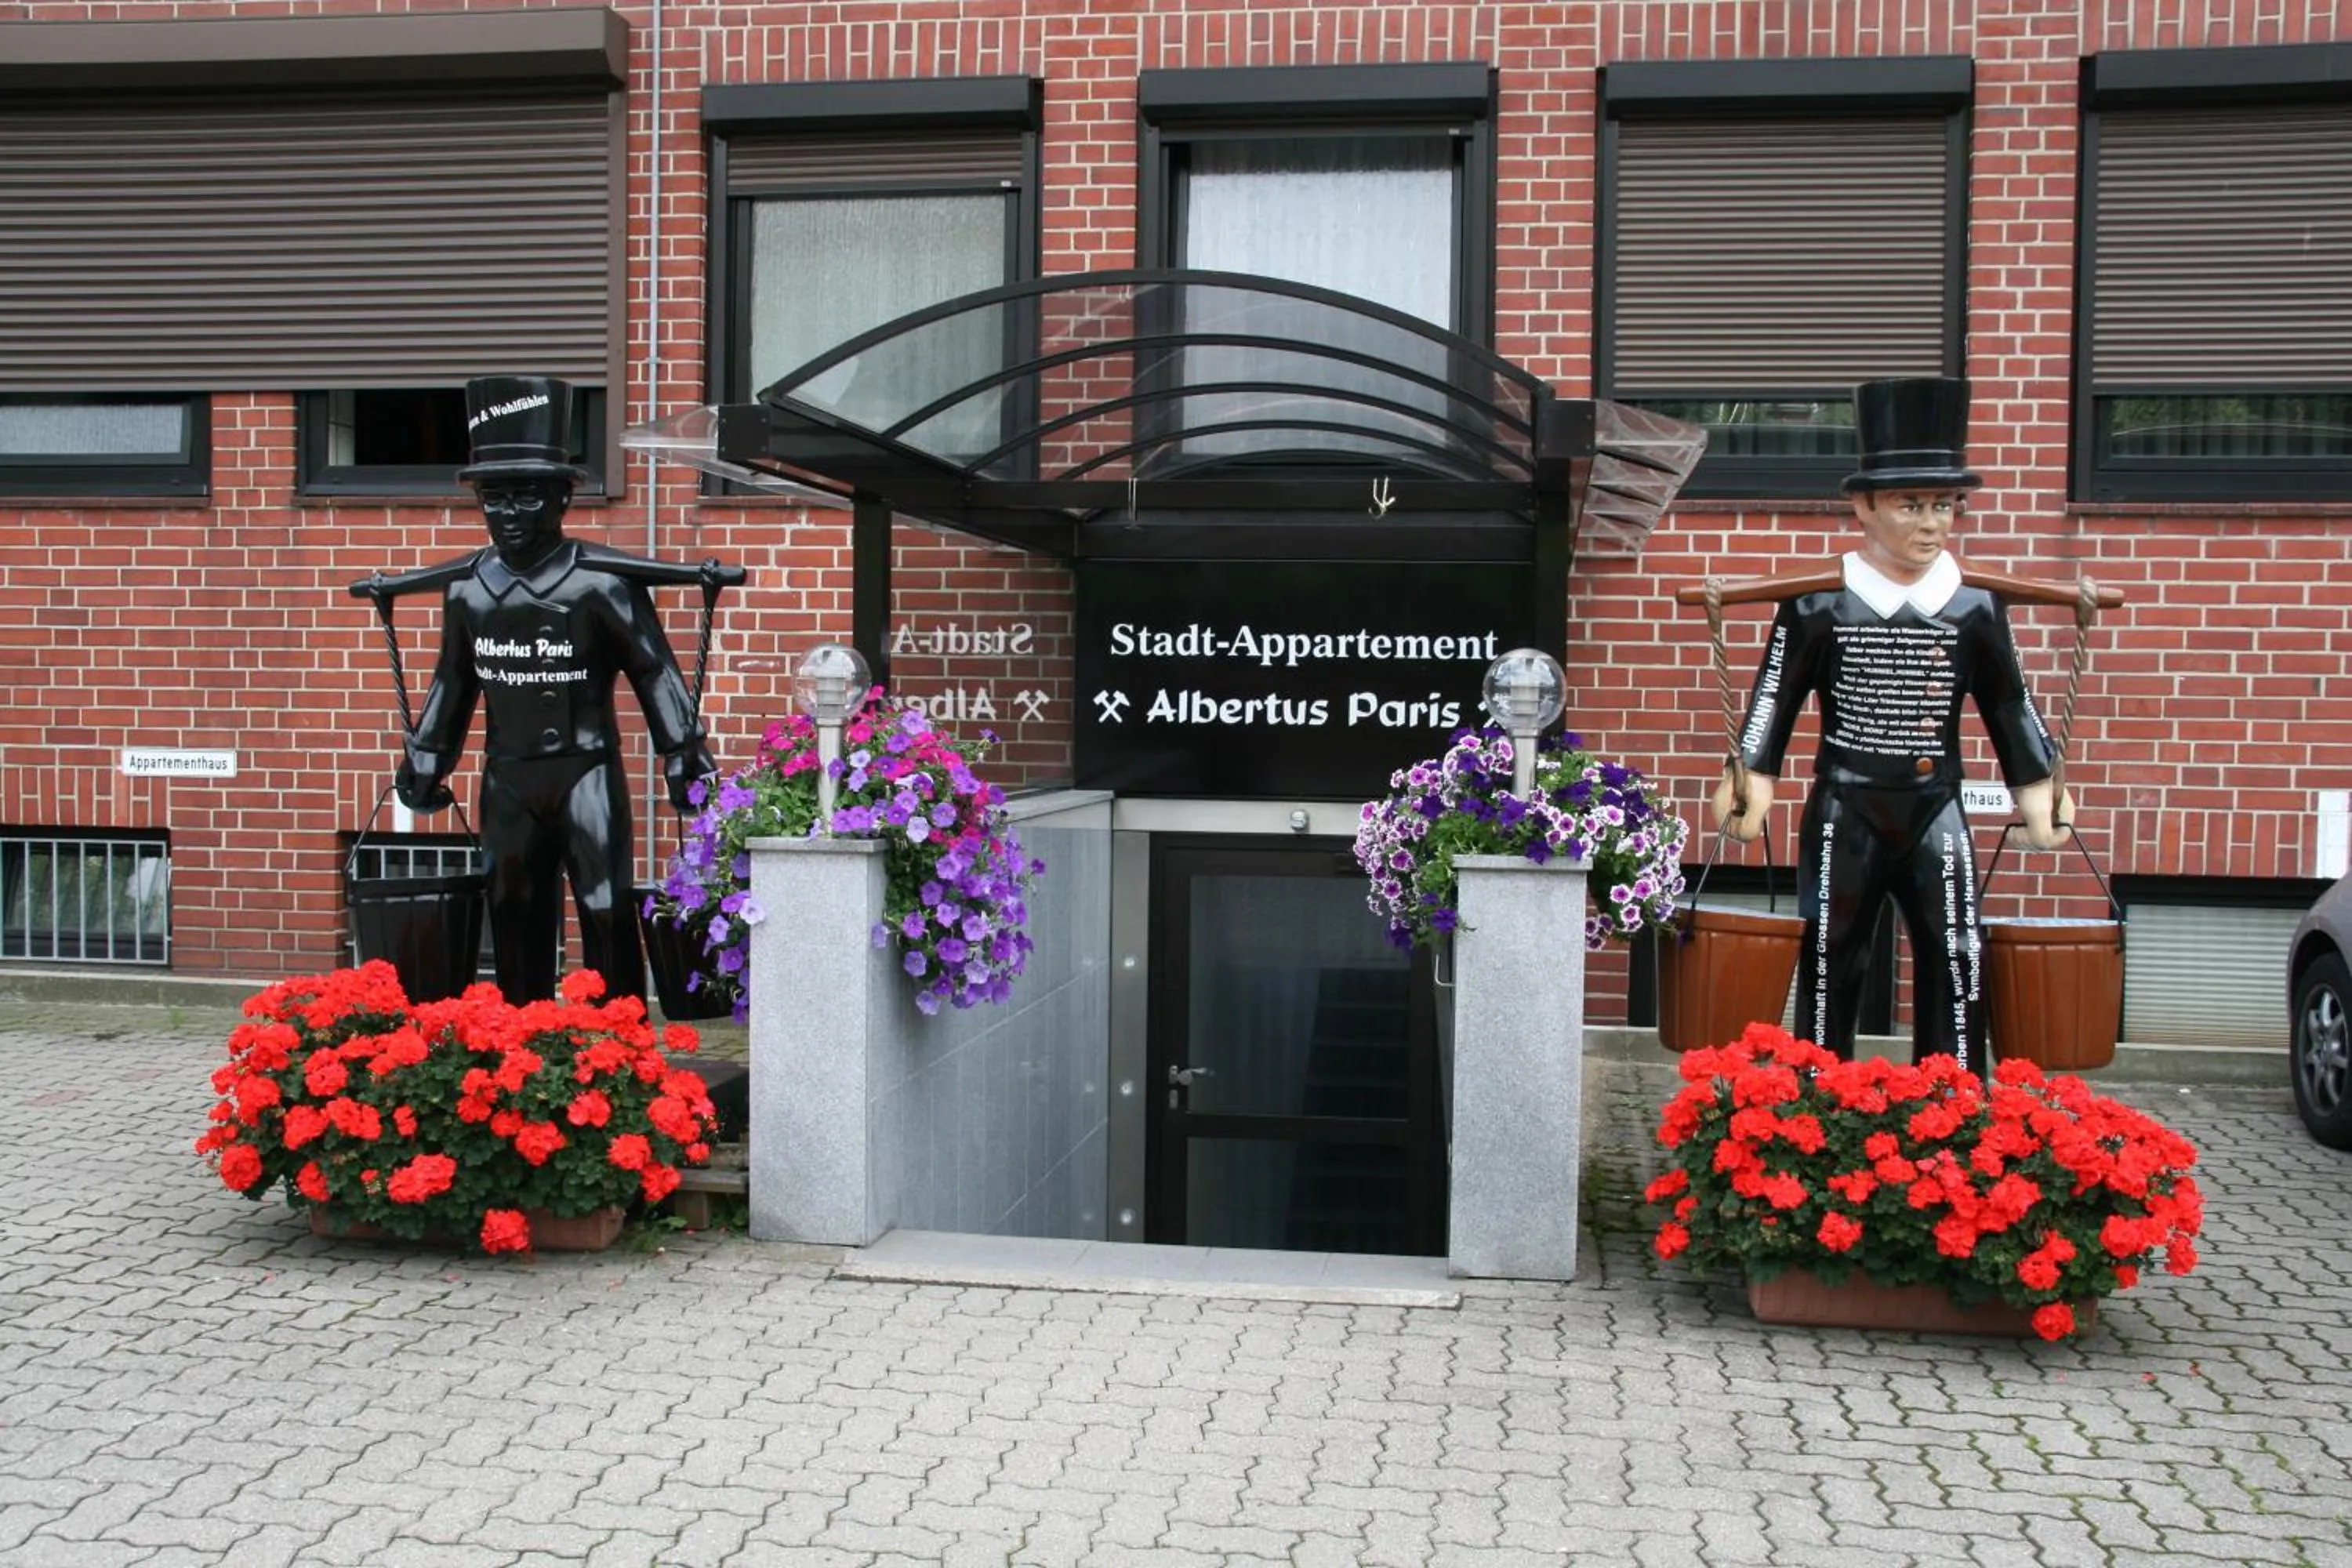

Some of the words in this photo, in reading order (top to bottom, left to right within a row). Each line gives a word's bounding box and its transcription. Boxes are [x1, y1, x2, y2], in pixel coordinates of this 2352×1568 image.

[481, 410, 489, 423] &
[489, 394, 550, 418] Wohlfühlen
[475, 637, 531, 657] Albertus
[536, 638, 573, 657] Paris
[1111, 623, 1498, 666] Stadt-Appartement
[1741, 695, 1776, 753] JOHANN
[1762, 625, 1788, 694] WILHELM
[1147, 688, 1330, 726] Albertus
[1348, 691, 1461, 729] Paris
[129, 754, 228, 771] Appartementhaus
[1823, 823, 1834, 837] 36
[1943, 833, 1953, 852] zur
[1819, 841, 1831, 899] Drehbahn
[1942, 855, 1955, 879] Tod
[1944, 880, 1956, 924] seinem
[1964, 904, 1976, 926] der
[1817, 902, 1828, 953] Grossen
[1944, 927, 1957, 958] nach
[1817, 956, 1827, 975] der
[1949, 960, 1963, 996] wurde
[1966, 927, 1981, 1002] Symbolfigur
[1815, 978, 1826, 989] in
[1814, 993, 1826, 1046] wohnhaft
[1954, 1000, 1966, 1031] 1845,
[1955, 1034, 1968, 1070] orben
